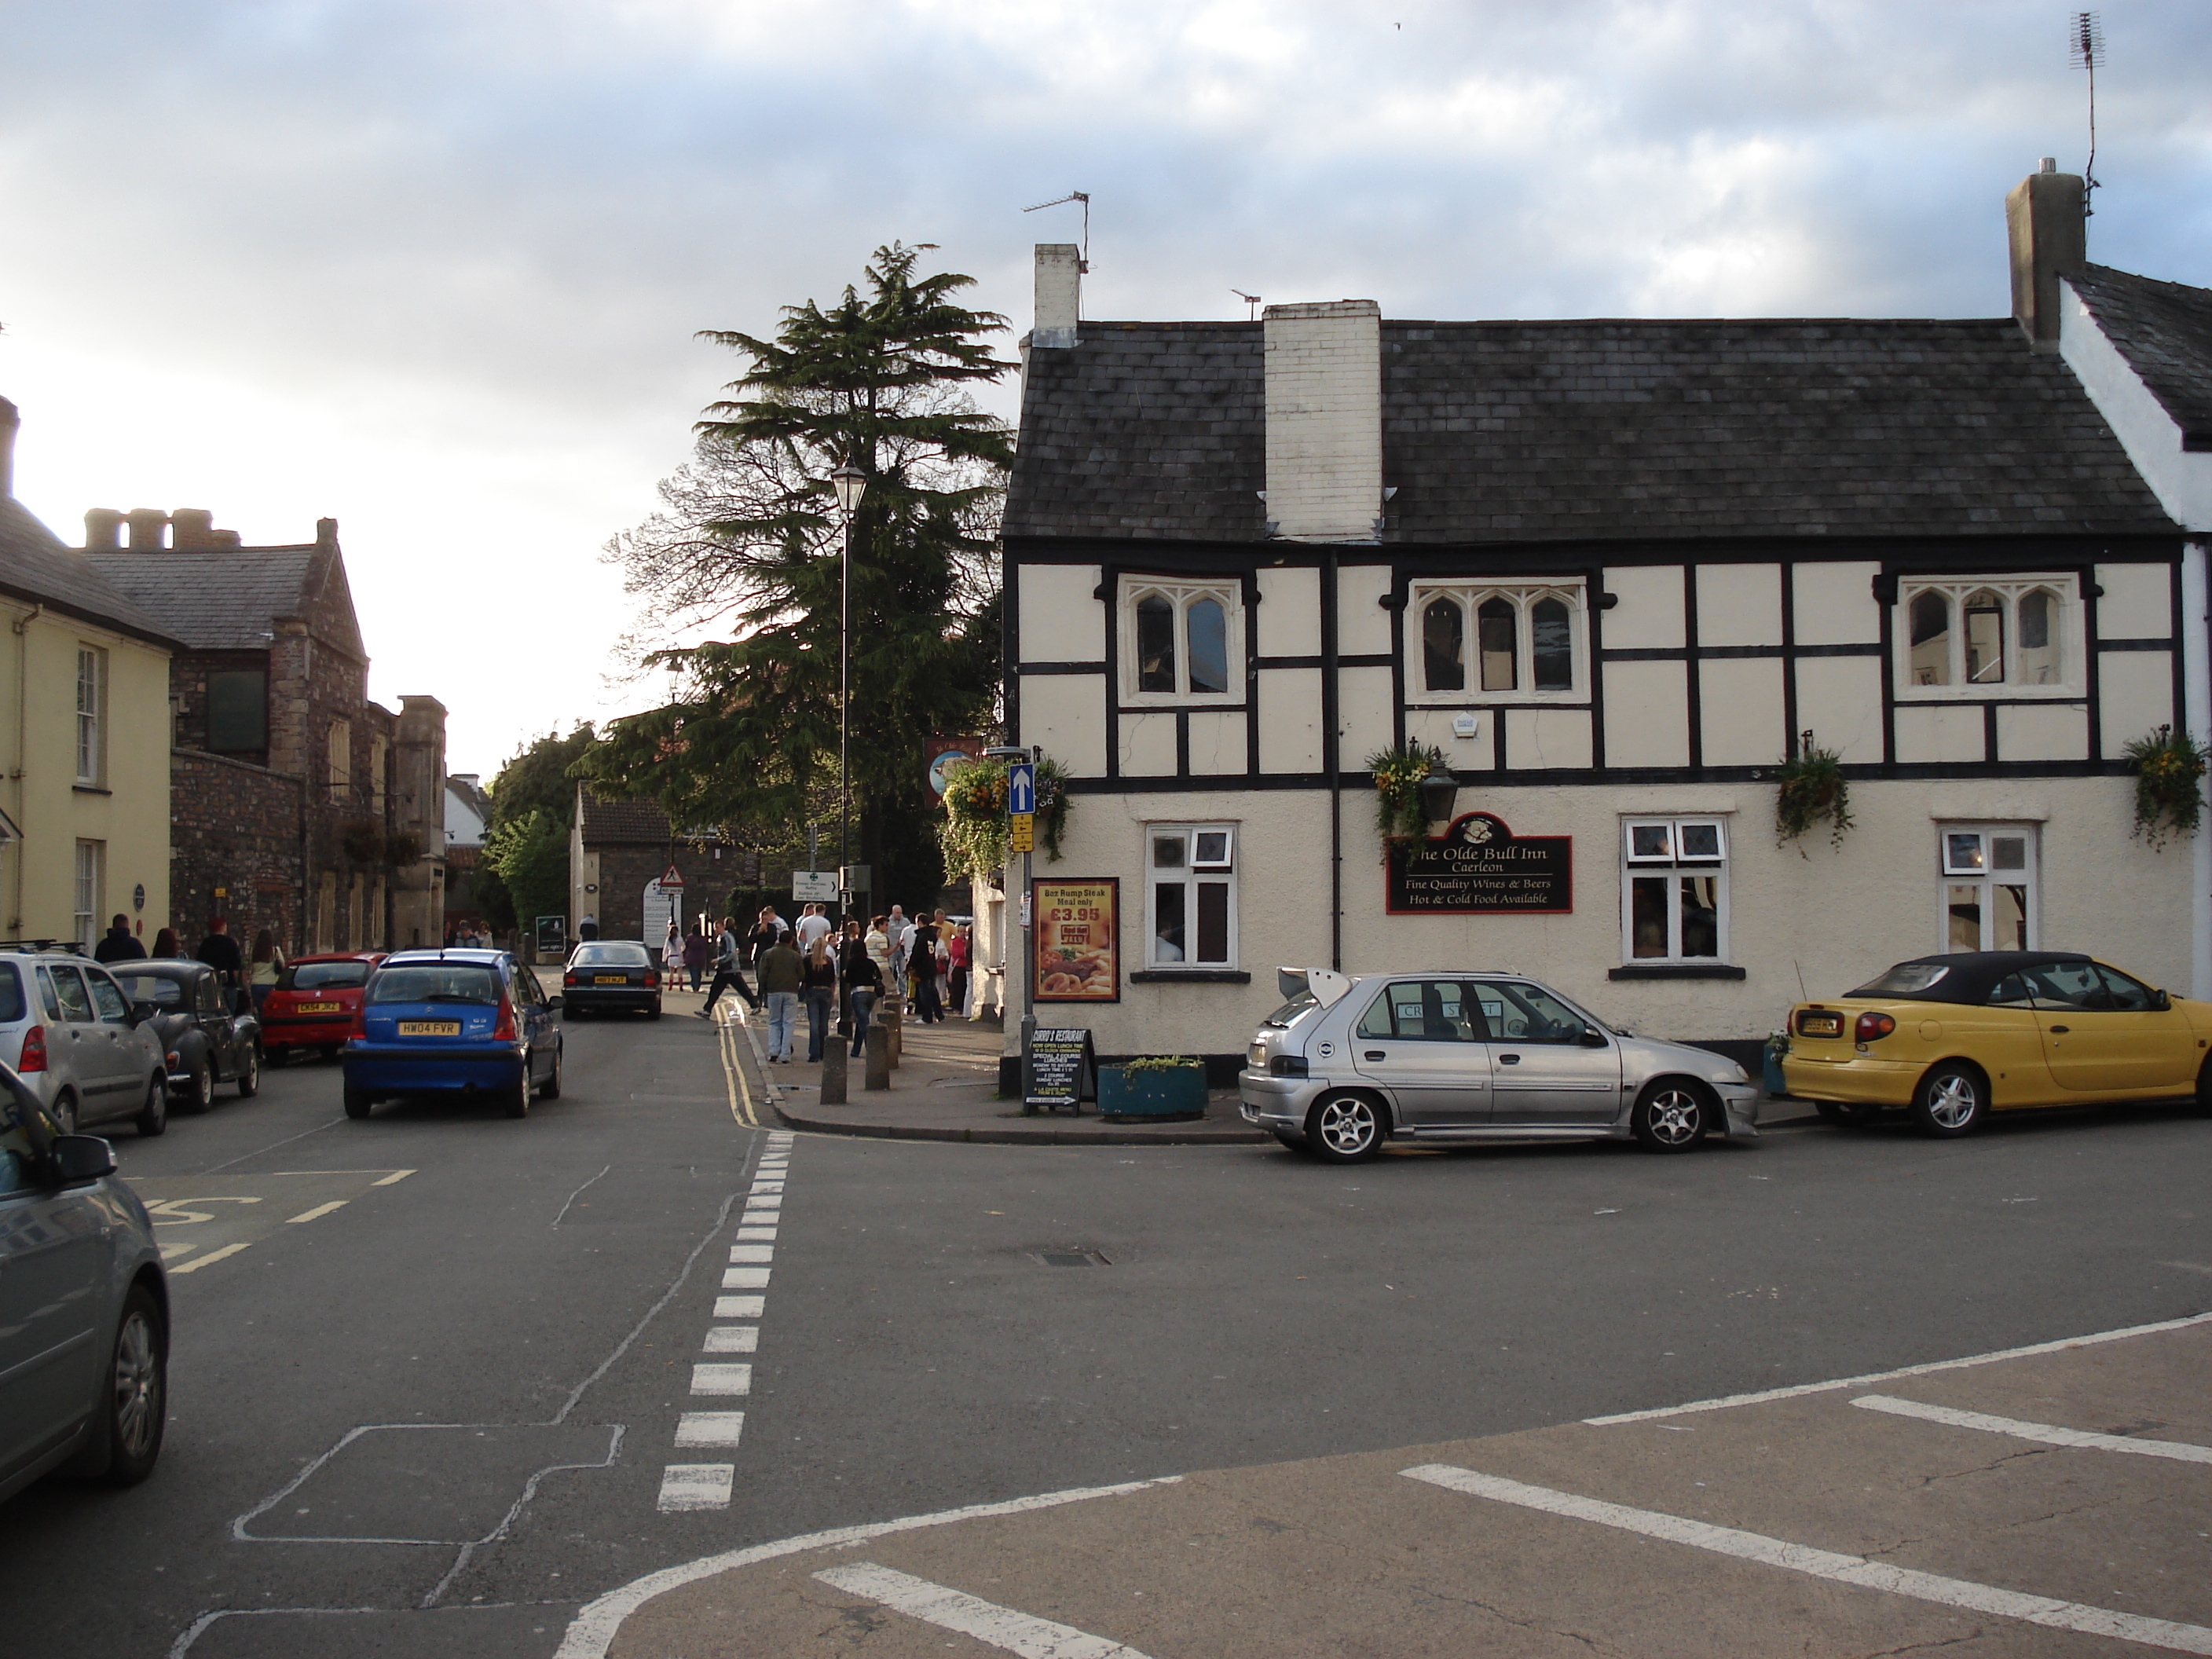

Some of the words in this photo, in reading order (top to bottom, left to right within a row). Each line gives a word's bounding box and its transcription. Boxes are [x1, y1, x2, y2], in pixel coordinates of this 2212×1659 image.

[1443, 846, 1478, 860] Olde
[1484, 846, 1518, 859] Bull
[1521, 848, 1549, 859] Inn
[1452, 860, 1504, 873] Caerleon
[1405, 880, 1427, 889] Fine
[1430, 878, 1470, 893] Quality
[1472, 879, 1506, 888] Wines
[1509, 880, 1521, 888] &
[1523, 879, 1551, 888] Beers
[1060, 889, 1082, 899] Rump
[1084, 888, 1105, 897] Steak
[1409, 895, 1430, 904] Hot
[1433, 895, 1445, 904] &
[1447, 893, 1471, 904] Cold
[1474, 893, 1498, 904] Food
[1500, 892, 1548, 903] Available
[1050, 908, 1100, 921] £3.95
[404, 1024, 430, 1033] HW04
[434, 1024, 453, 1033] FVR
[1055, 1030, 1086, 1042] RESTAURANT
